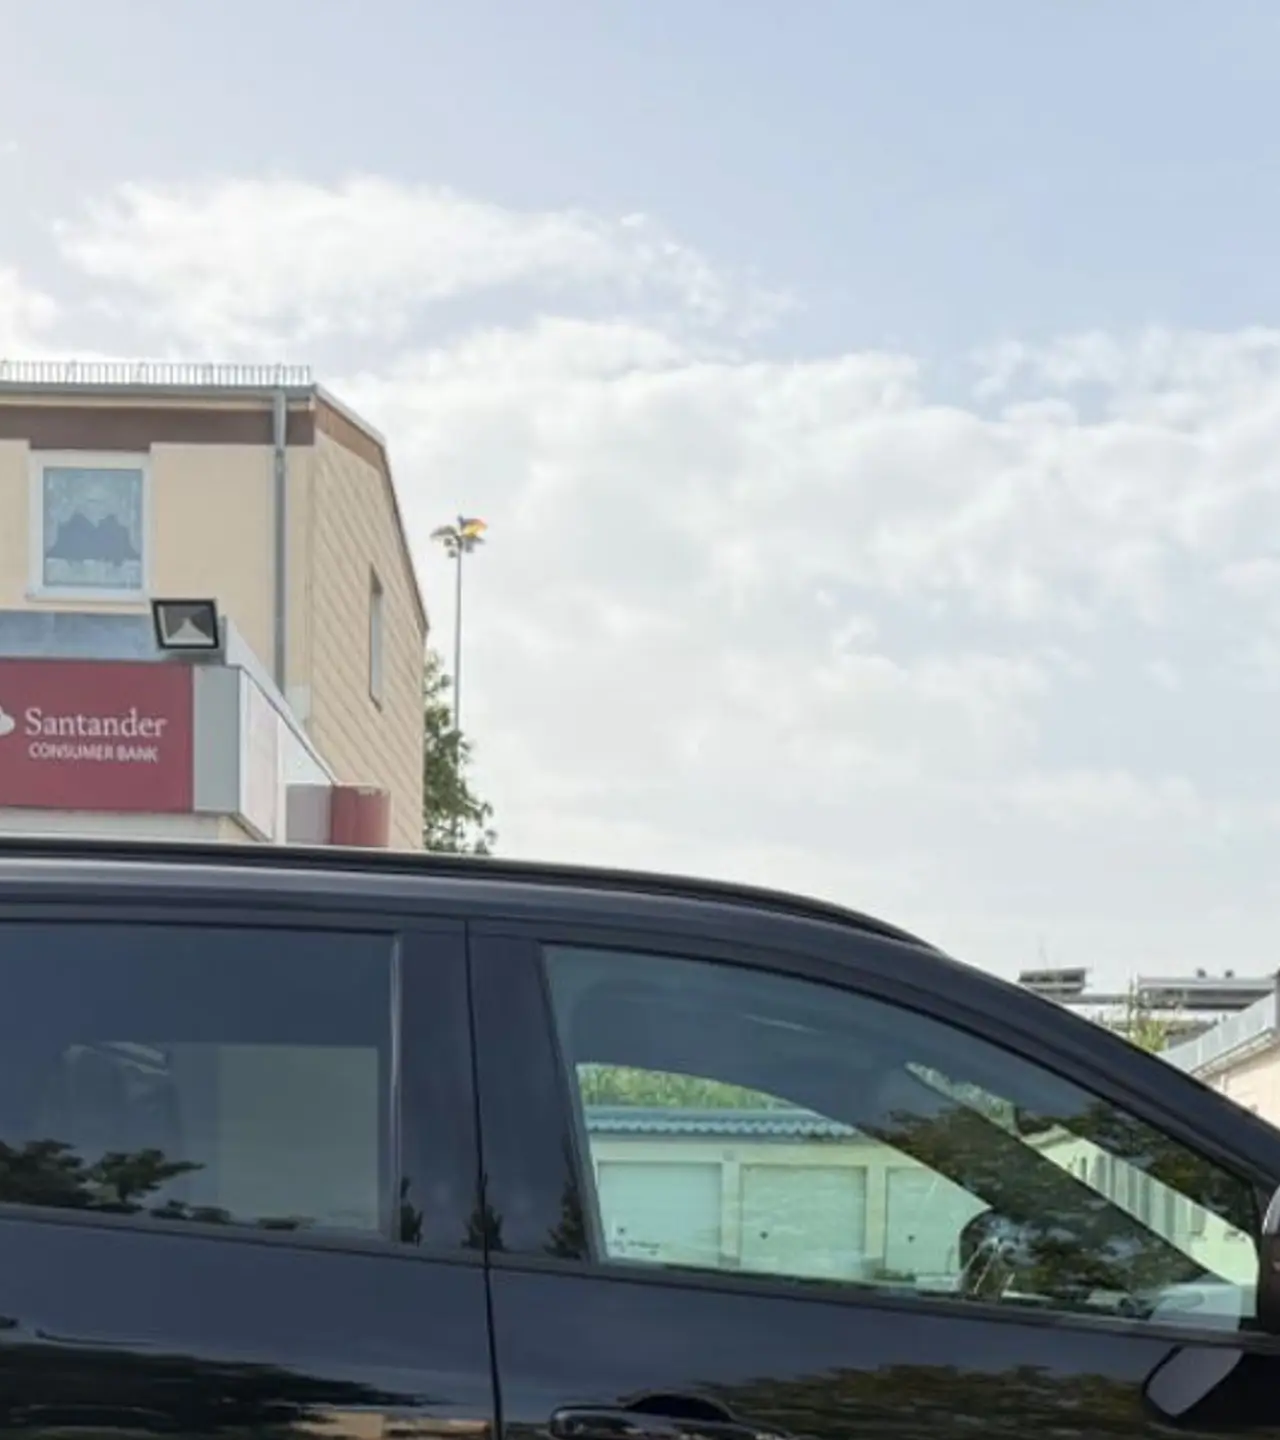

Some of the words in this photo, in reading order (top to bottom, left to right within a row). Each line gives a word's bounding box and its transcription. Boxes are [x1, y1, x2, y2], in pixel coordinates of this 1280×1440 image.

[25, 707, 168, 737] Santander
[28, 742, 113, 761] CONSUMER
[117, 744, 158, 763] BANK
